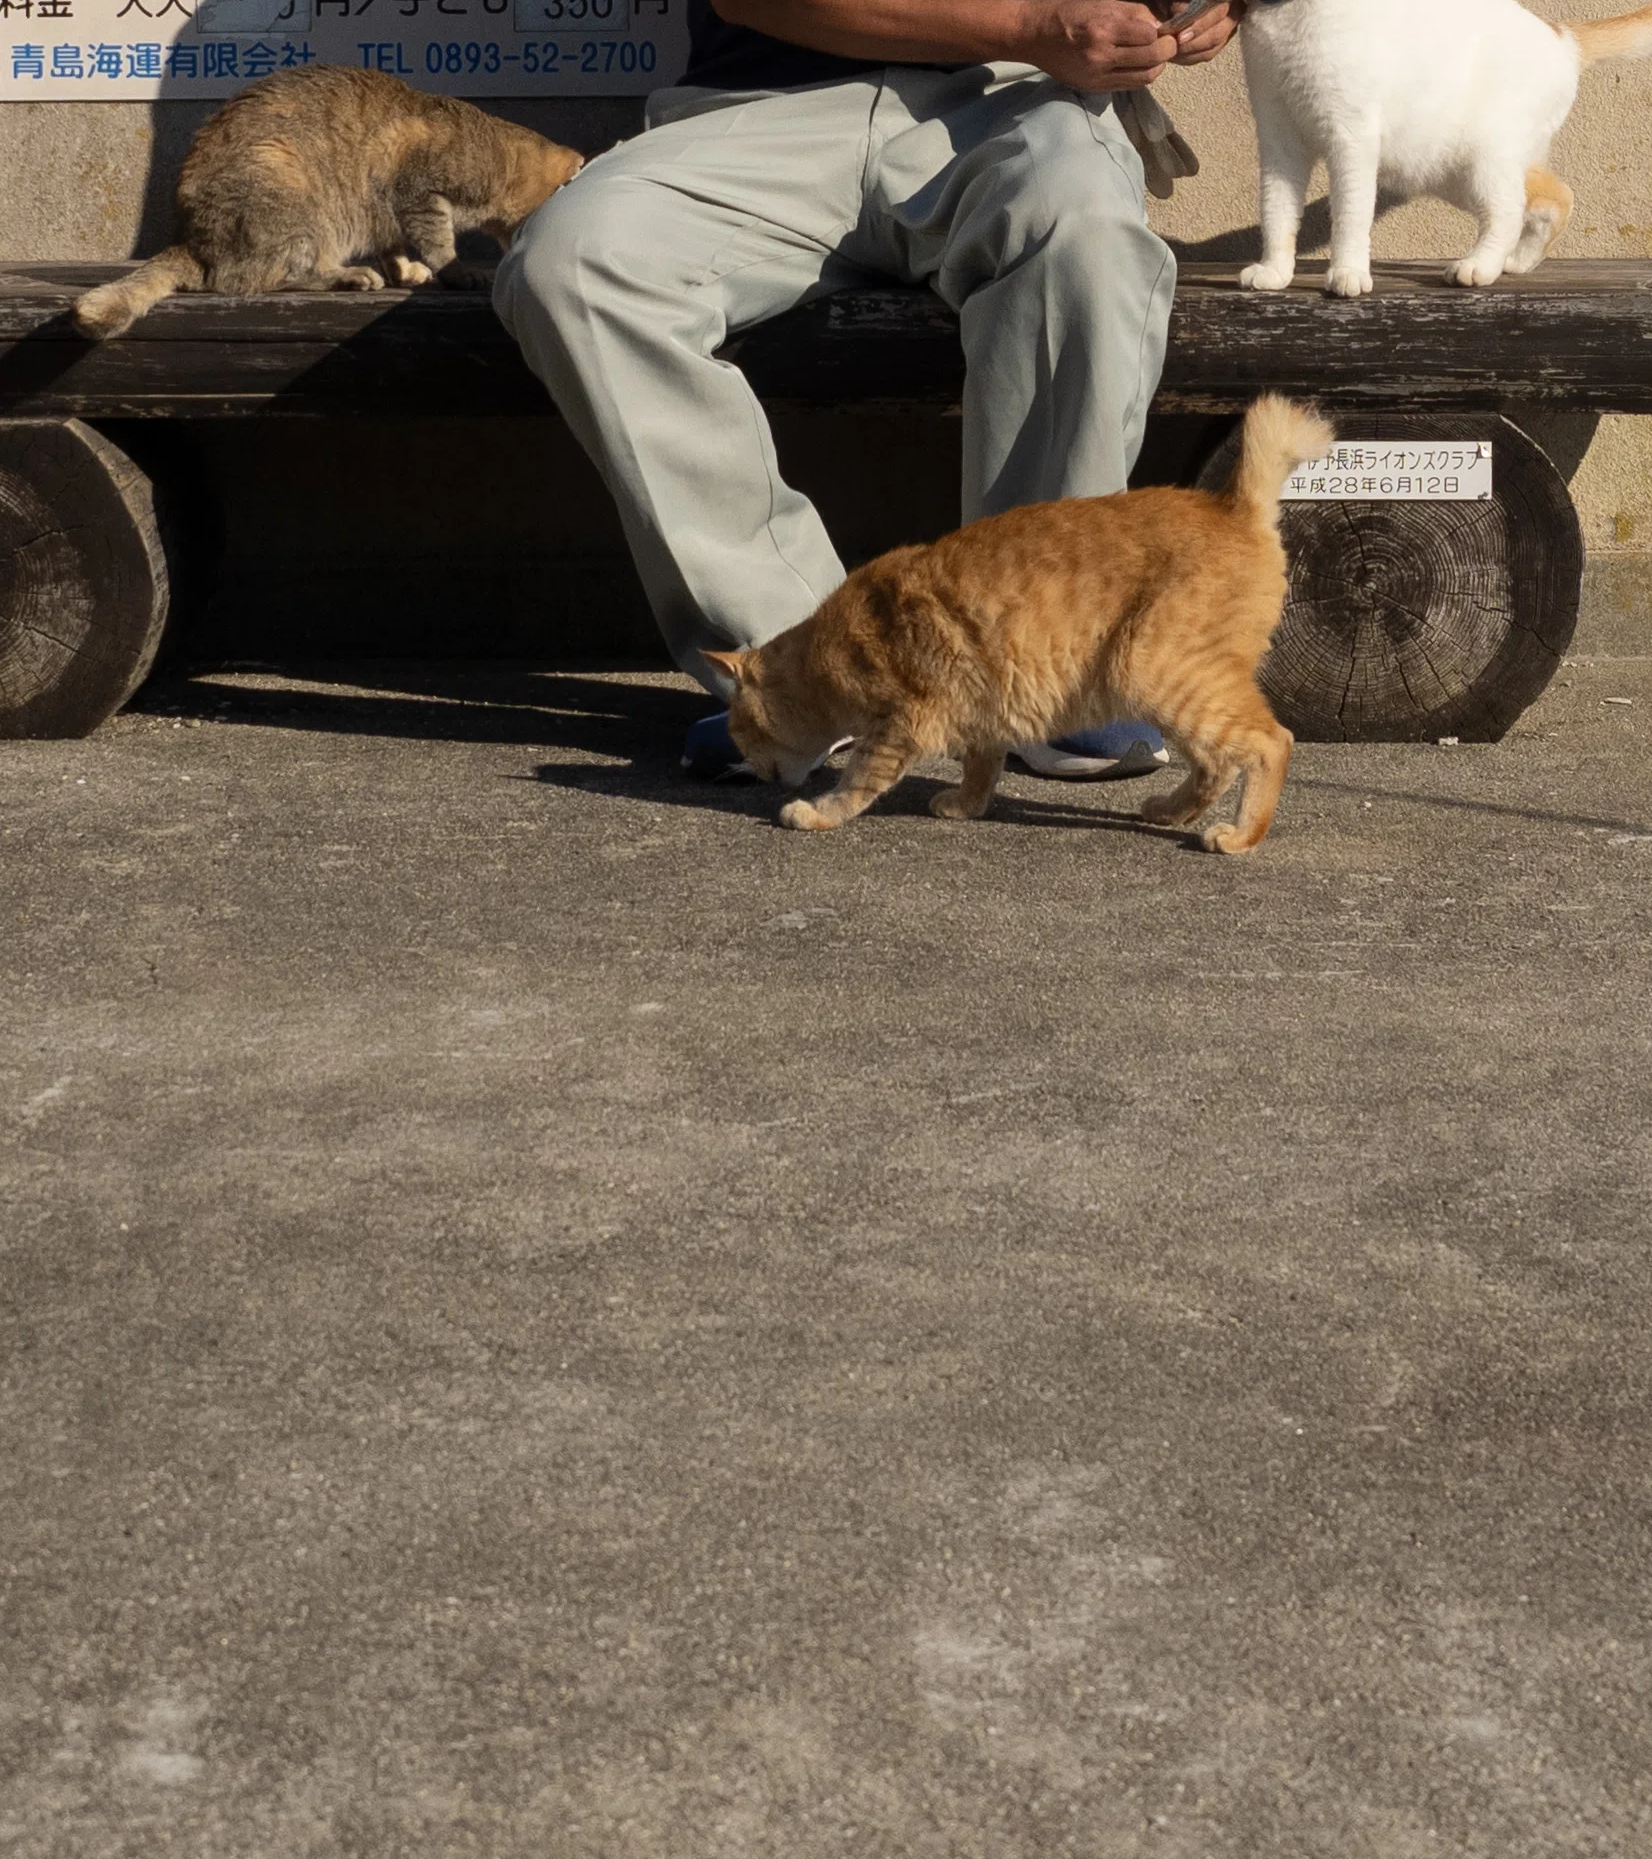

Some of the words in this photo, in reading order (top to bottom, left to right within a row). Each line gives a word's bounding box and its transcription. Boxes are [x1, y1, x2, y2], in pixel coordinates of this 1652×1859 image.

[10, 41, 317, 80] 青島海運有限会社
[358, 42, 414, 74] TEL
[425, 42, 658, 74] 0893-52-2700
[1290, 477, 1460, 494] 平成28年6月12日
